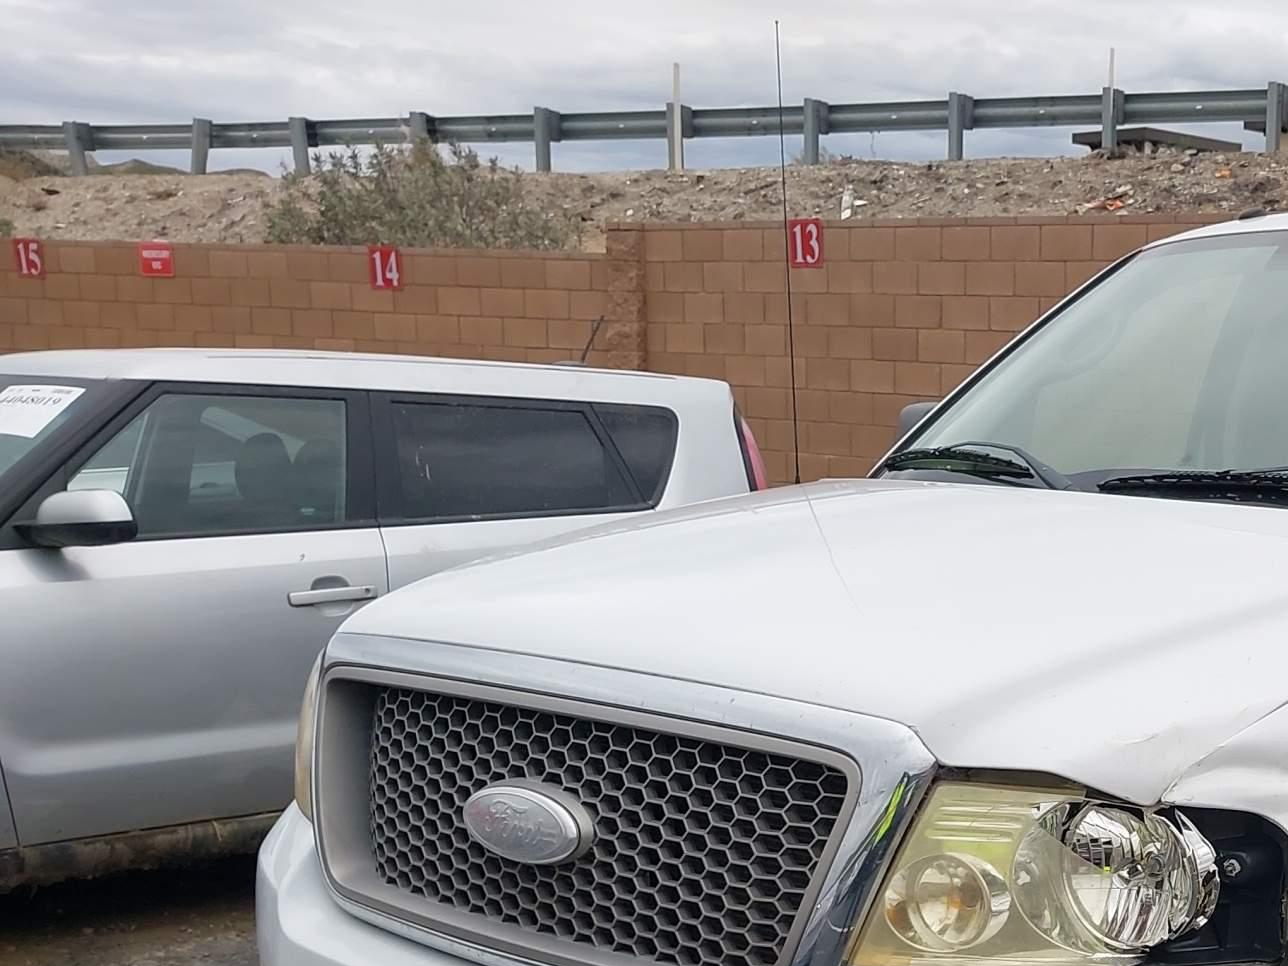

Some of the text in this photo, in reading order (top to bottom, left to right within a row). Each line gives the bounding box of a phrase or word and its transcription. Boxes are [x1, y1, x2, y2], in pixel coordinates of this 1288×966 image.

[17, 242, 41, 275] 15
[792, 223, 819, 264] 13
[372, 245, 399, 286] 14
